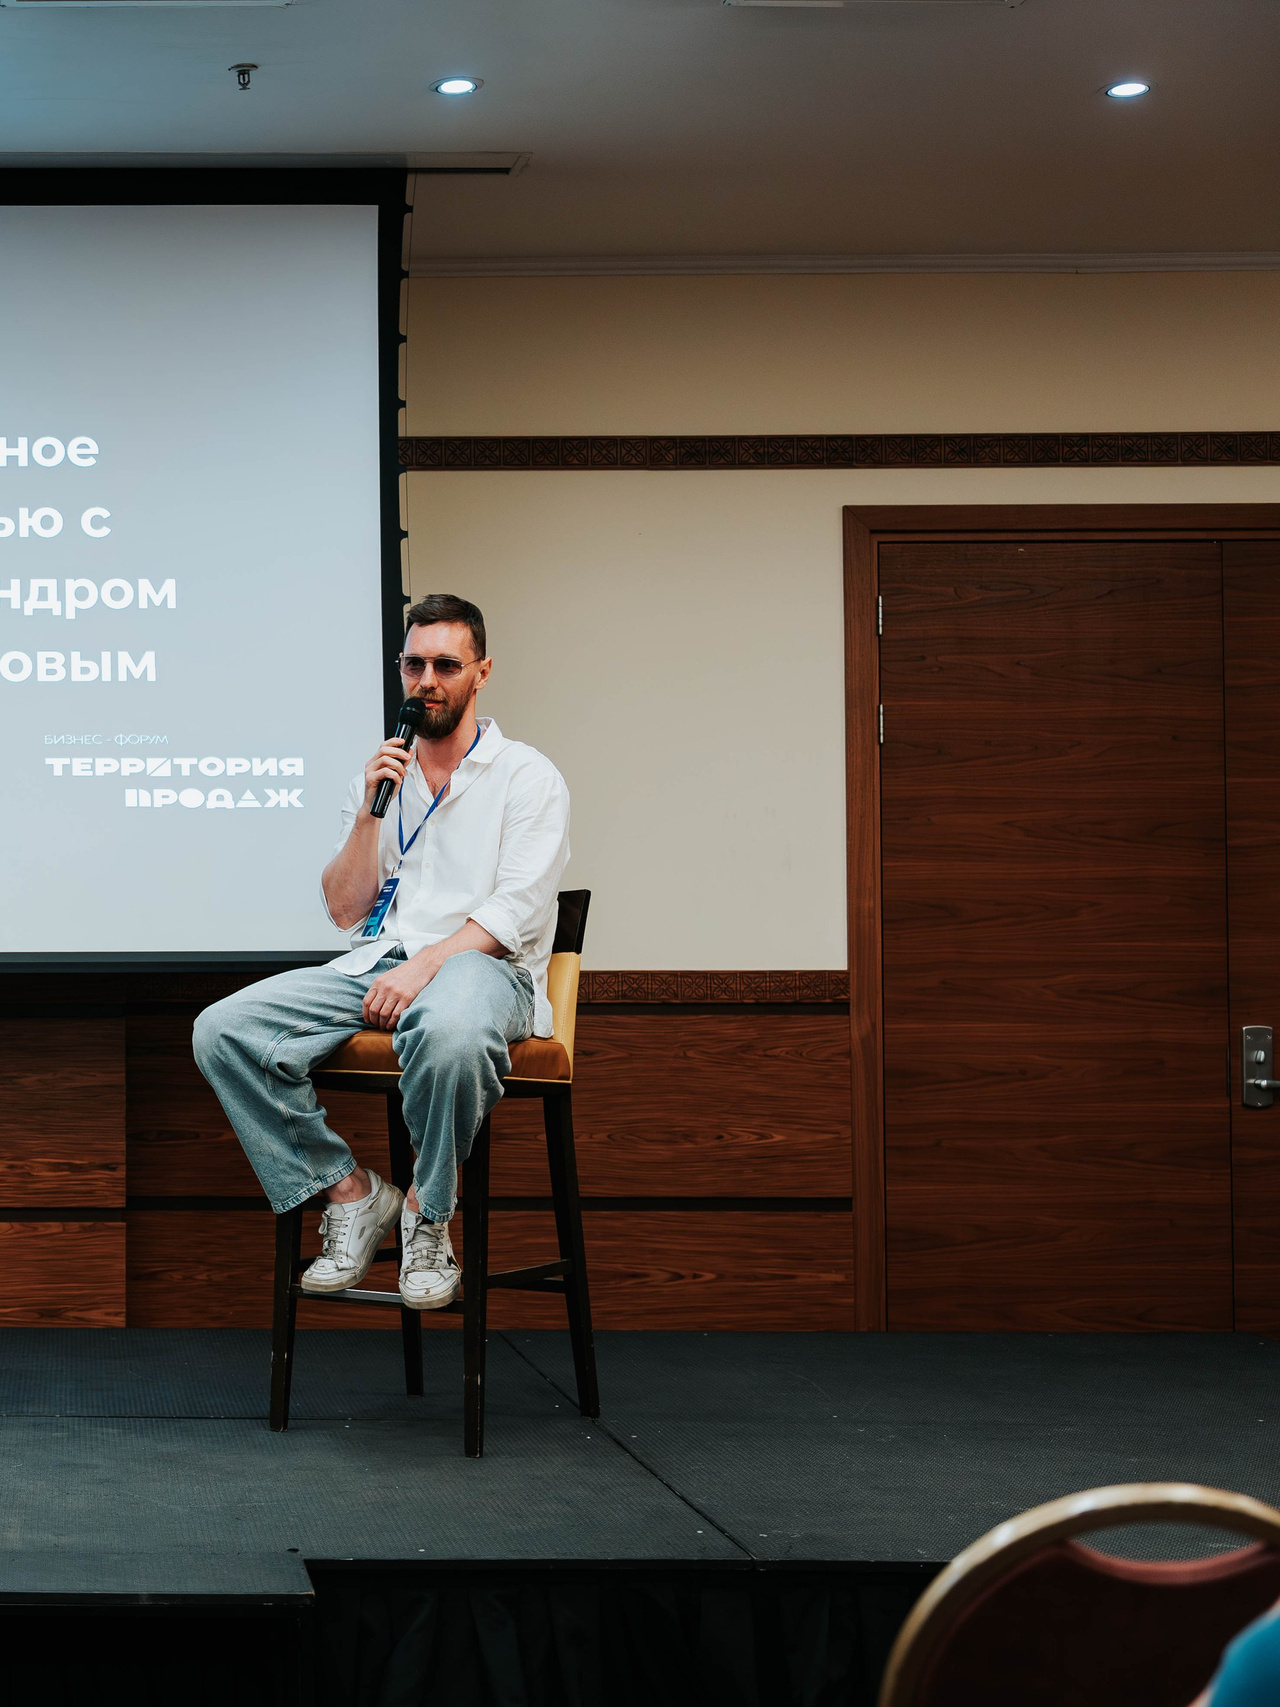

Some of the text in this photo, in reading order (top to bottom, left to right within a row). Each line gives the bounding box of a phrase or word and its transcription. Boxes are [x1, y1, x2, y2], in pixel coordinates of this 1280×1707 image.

[81, 506, 112, 538] с
[44, 734, 103, 745] БИЗНЕС
[114, 733, 169, 746] ФОРУМ
[45, 757, 305, 777] ТЕРРИТОРИЯ
[124, 787, 305, 809] ПРОДАЖ
